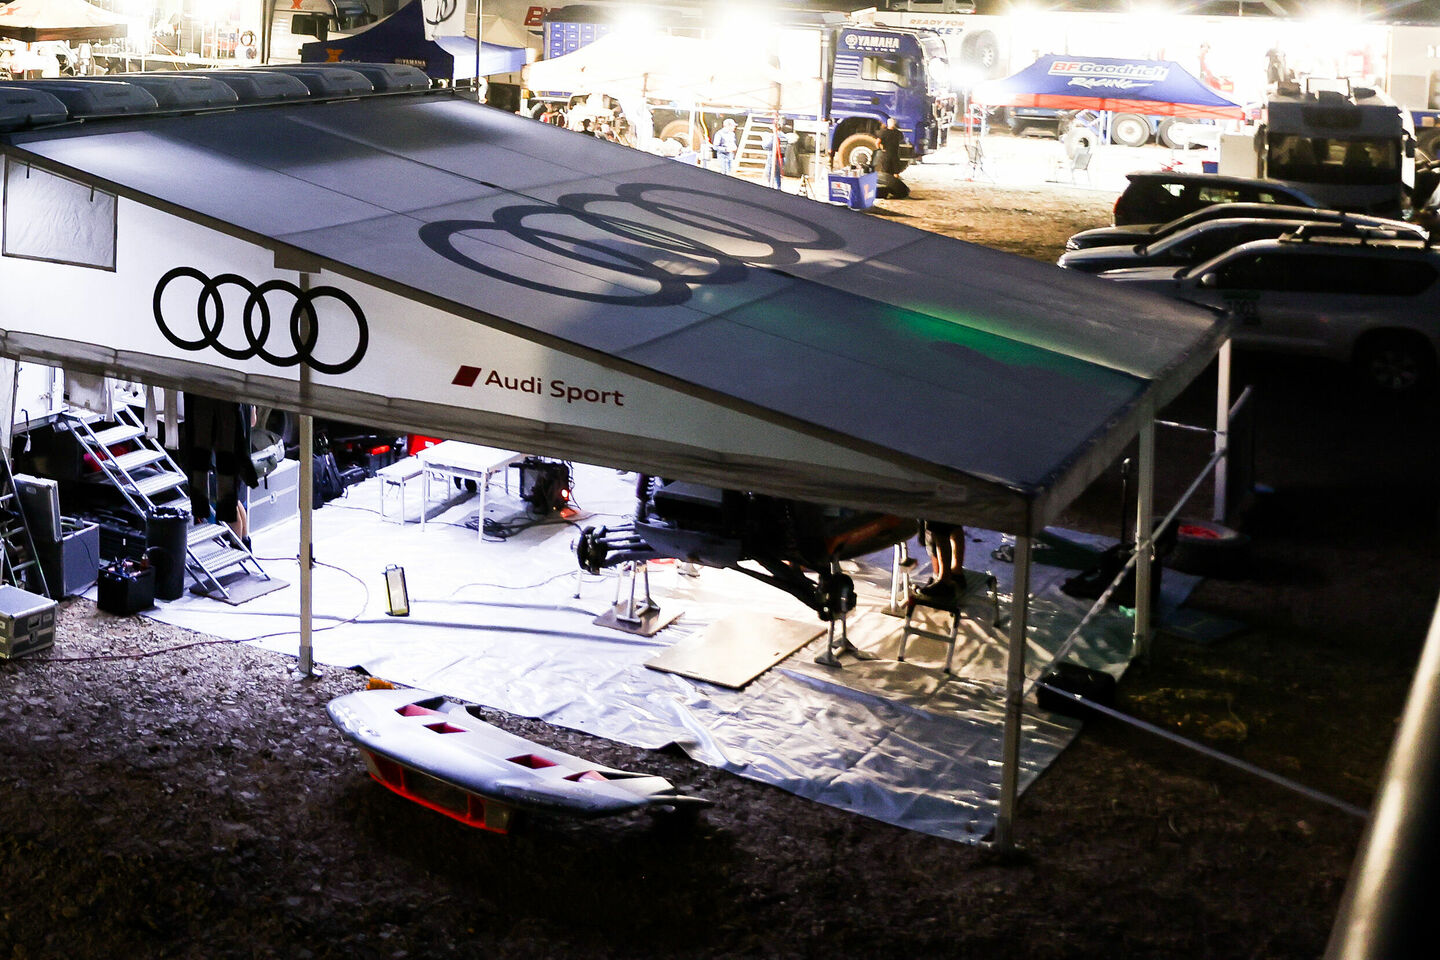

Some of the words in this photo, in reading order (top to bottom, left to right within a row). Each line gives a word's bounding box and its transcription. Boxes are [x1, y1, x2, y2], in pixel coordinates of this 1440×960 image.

[858, 35, 900, 48] YAMAHA
[1052, 61, 1168, 77] BFGoodrich
[484, 370, 543, 395] Audi
[550, 380, 625, 407] Sport
